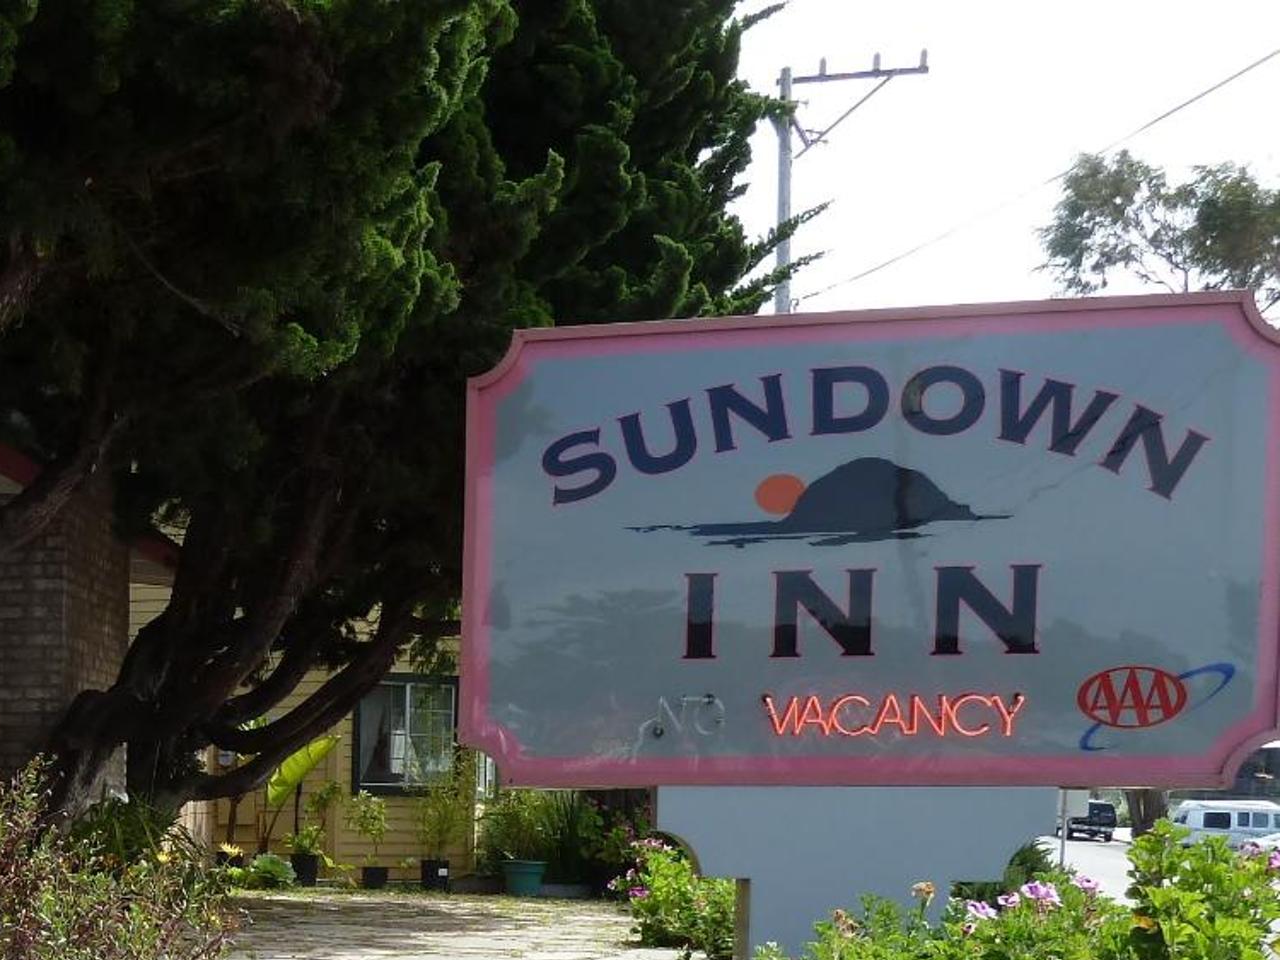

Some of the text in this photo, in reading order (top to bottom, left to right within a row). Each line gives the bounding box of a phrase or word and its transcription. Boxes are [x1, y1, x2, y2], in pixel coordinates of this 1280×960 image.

[539, 363, 1213, 506] SUNDOWN
[681, 563, 1043, 659] INN
[657, 694, 1025, 737] NO VACANCY
[1083, 666, 1181, 727] AAA
